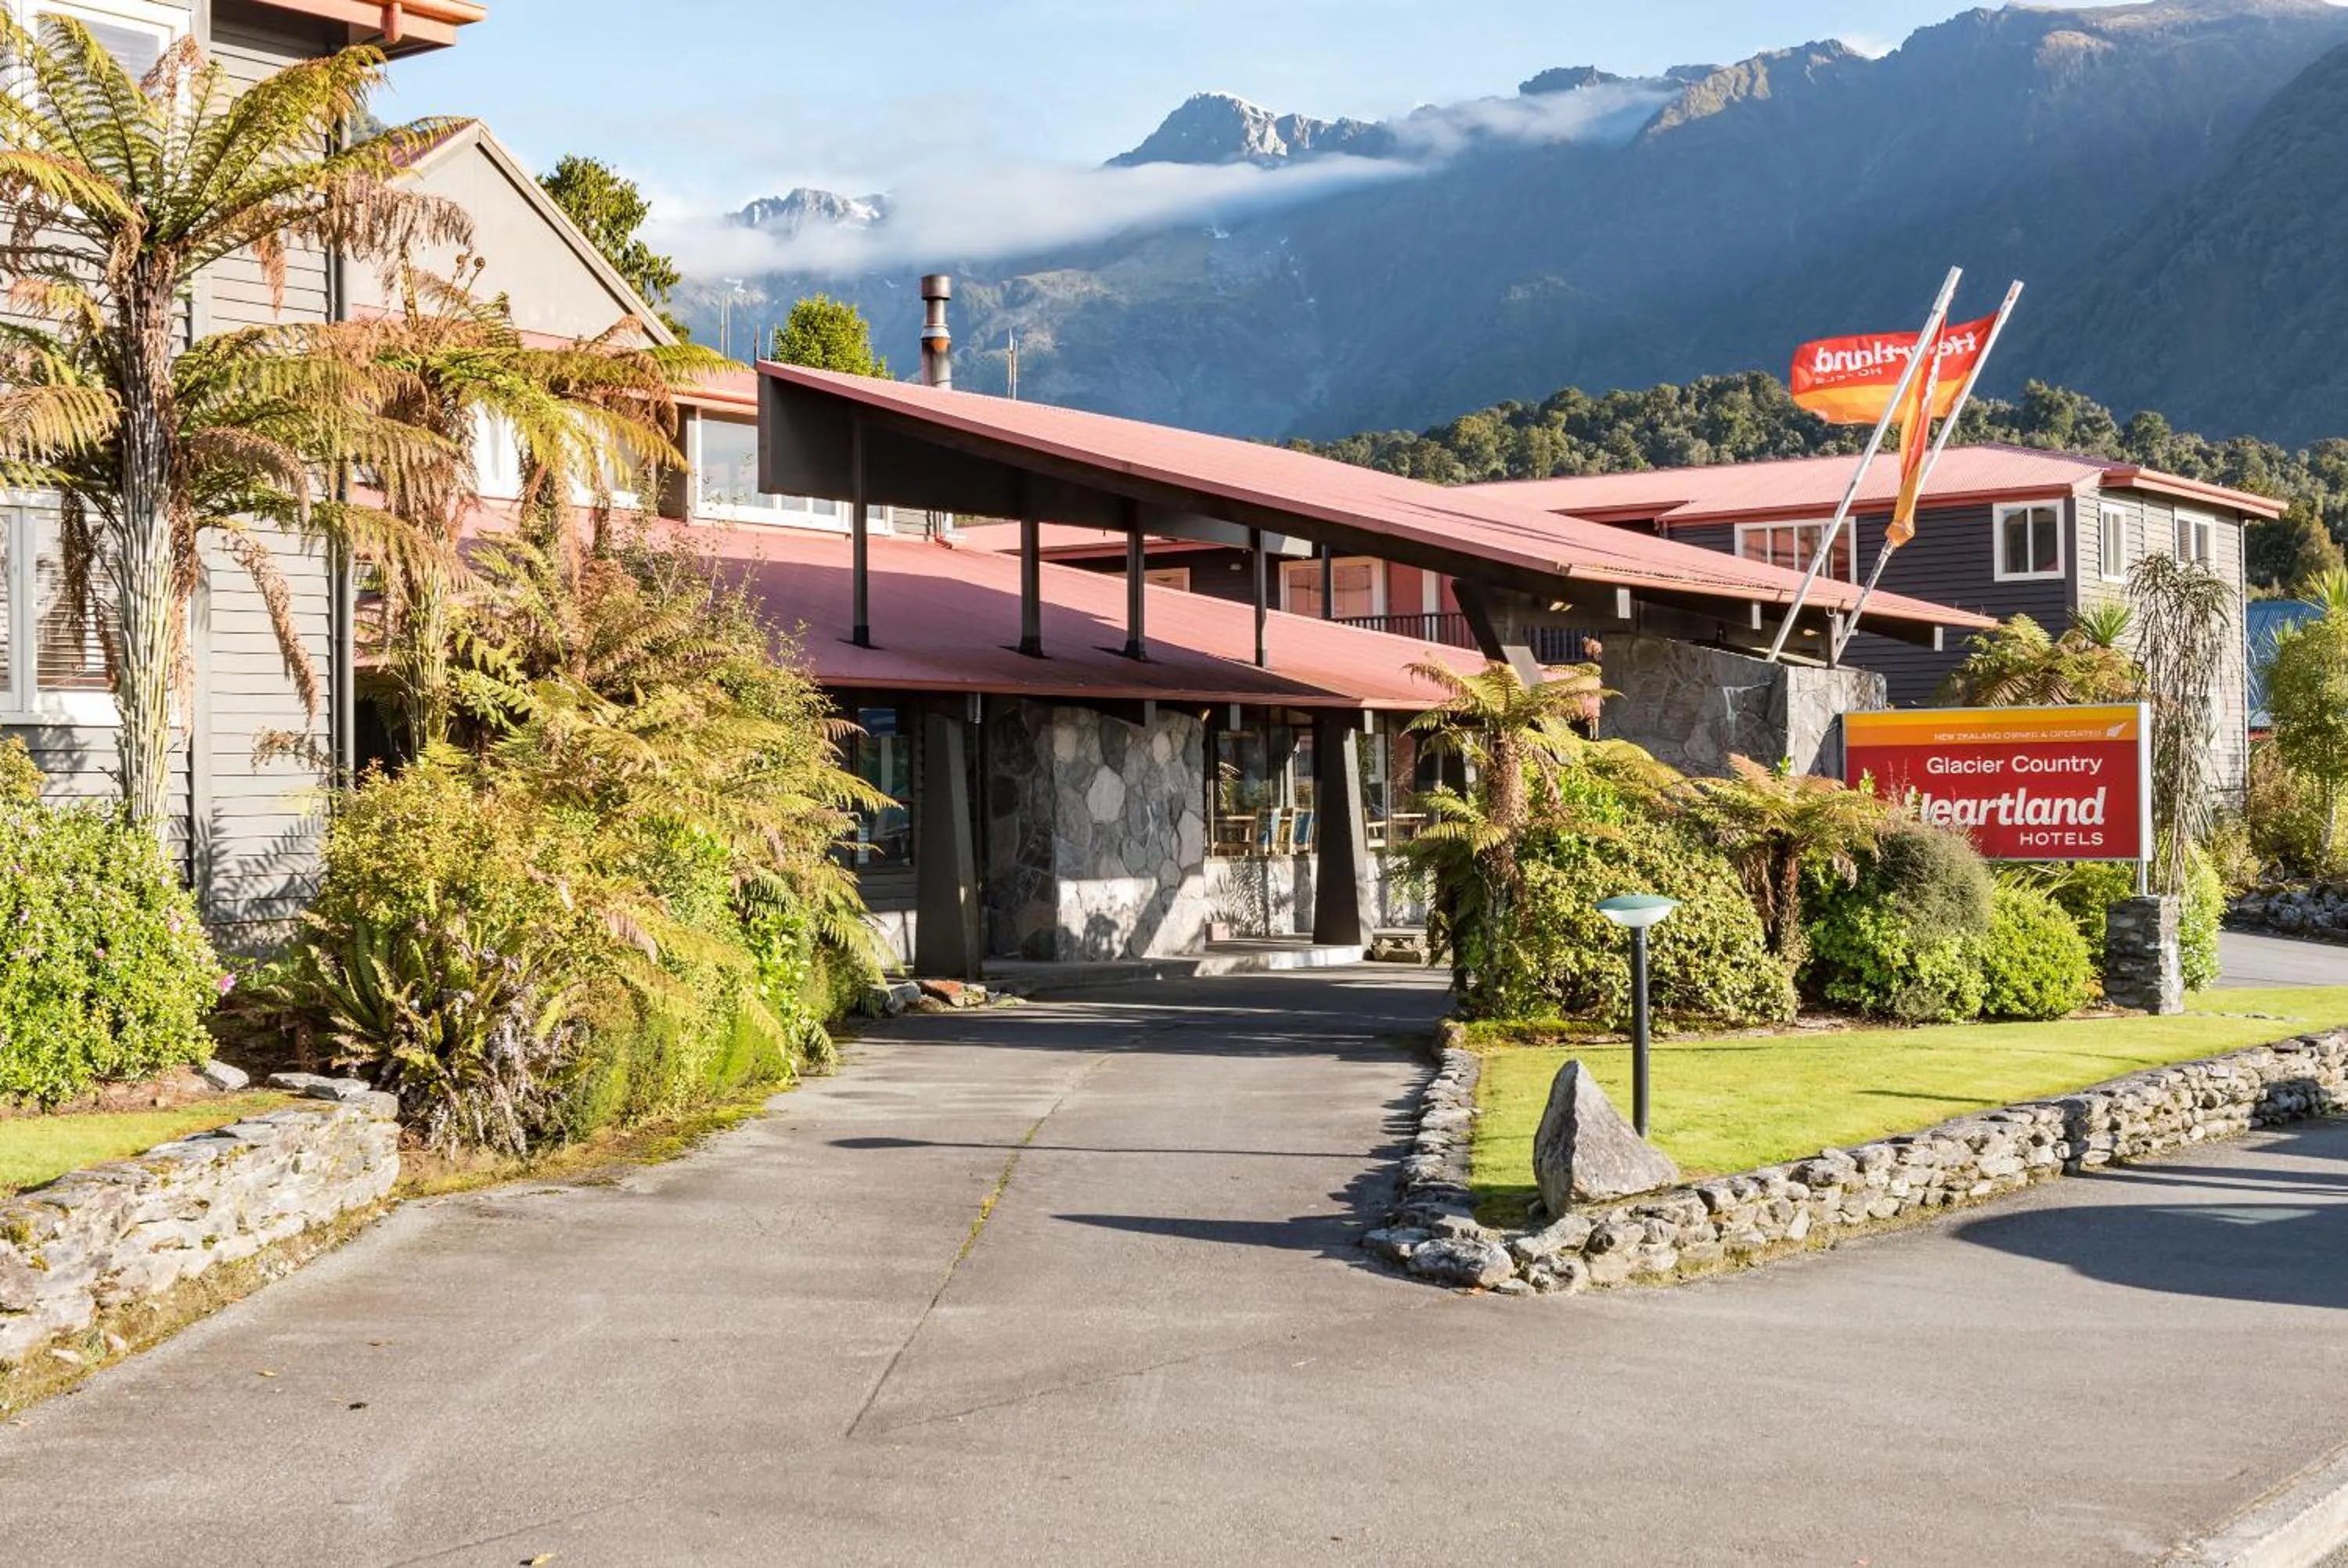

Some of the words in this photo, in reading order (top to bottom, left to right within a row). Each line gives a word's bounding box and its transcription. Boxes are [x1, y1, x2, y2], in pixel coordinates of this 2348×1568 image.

[1934, 732, 1954, 741] NEW
[1956, 731, 2001, 740] ZEALAND
[1926, 756, 2004, 774] Glacier
[2011, 755, 2103, 775] Country
[2019, 832, 2105, 846] HOTELS
